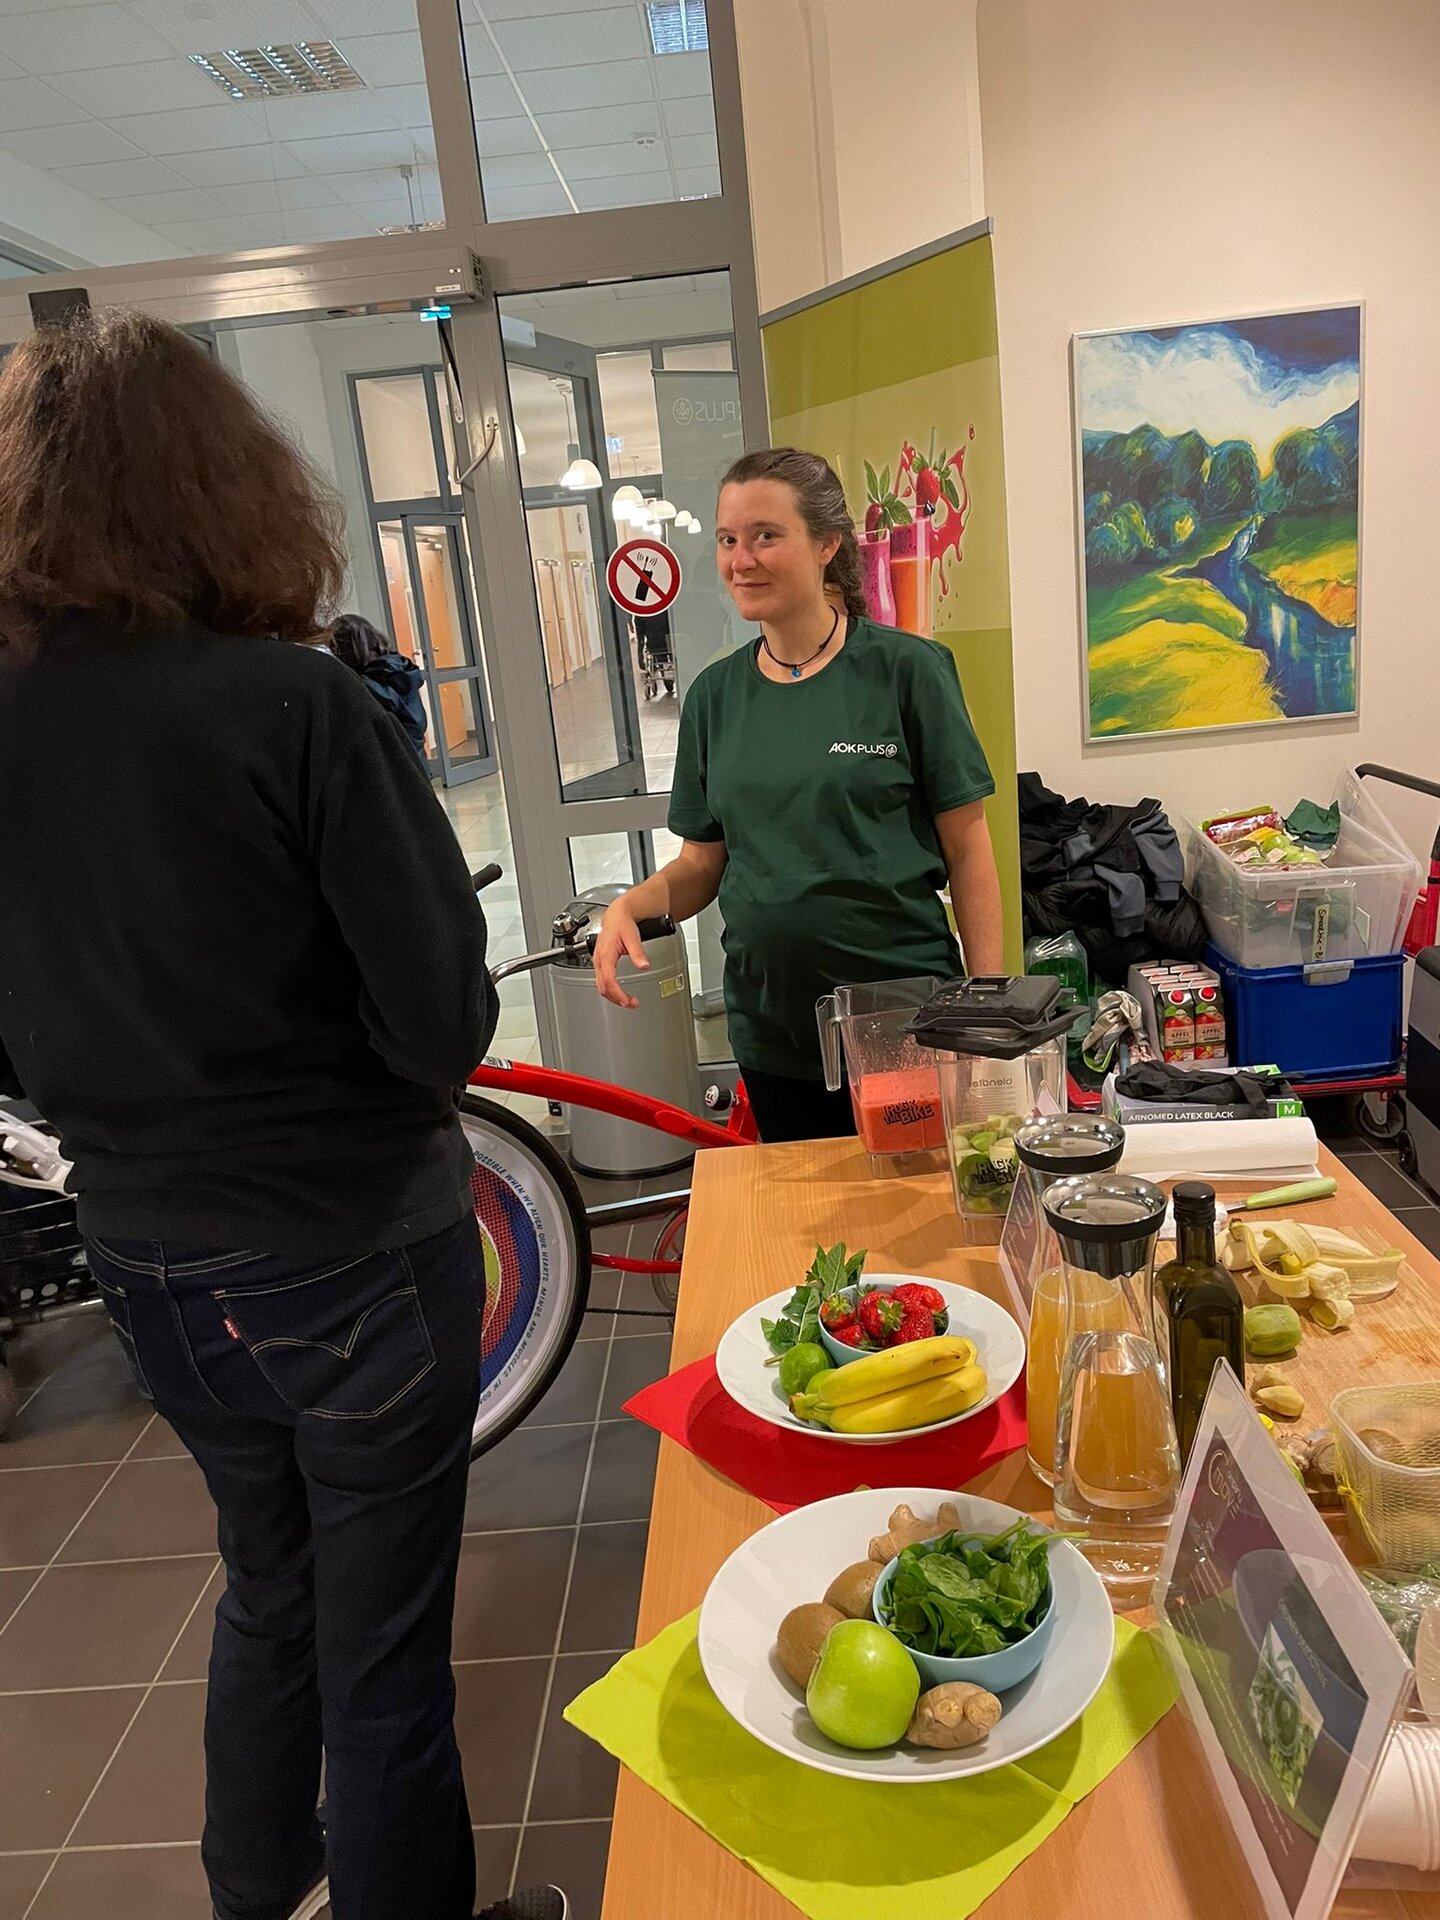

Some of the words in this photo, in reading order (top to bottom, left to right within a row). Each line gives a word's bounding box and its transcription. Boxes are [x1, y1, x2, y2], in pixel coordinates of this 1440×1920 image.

[900, 1104, 935, 1125] BIKE
[1128, 1113, 1173, 1122] ARNOMED
[1175, 1112, 1203, 1121] LATEX
[1204, 1111, 1235, 1119] BLACK
[1283, 1102, 1297, 1115] M
[505, 1173, 526, 1195] WHEN
[522, 1194, 535, 1207] WE
[529, 1208, 544, 1231] ALIGN
[538, 1232, 548, 1249] OUR
[526, 1320, 538, 1339] AND
[493, 1380, 502, 1393] IN
